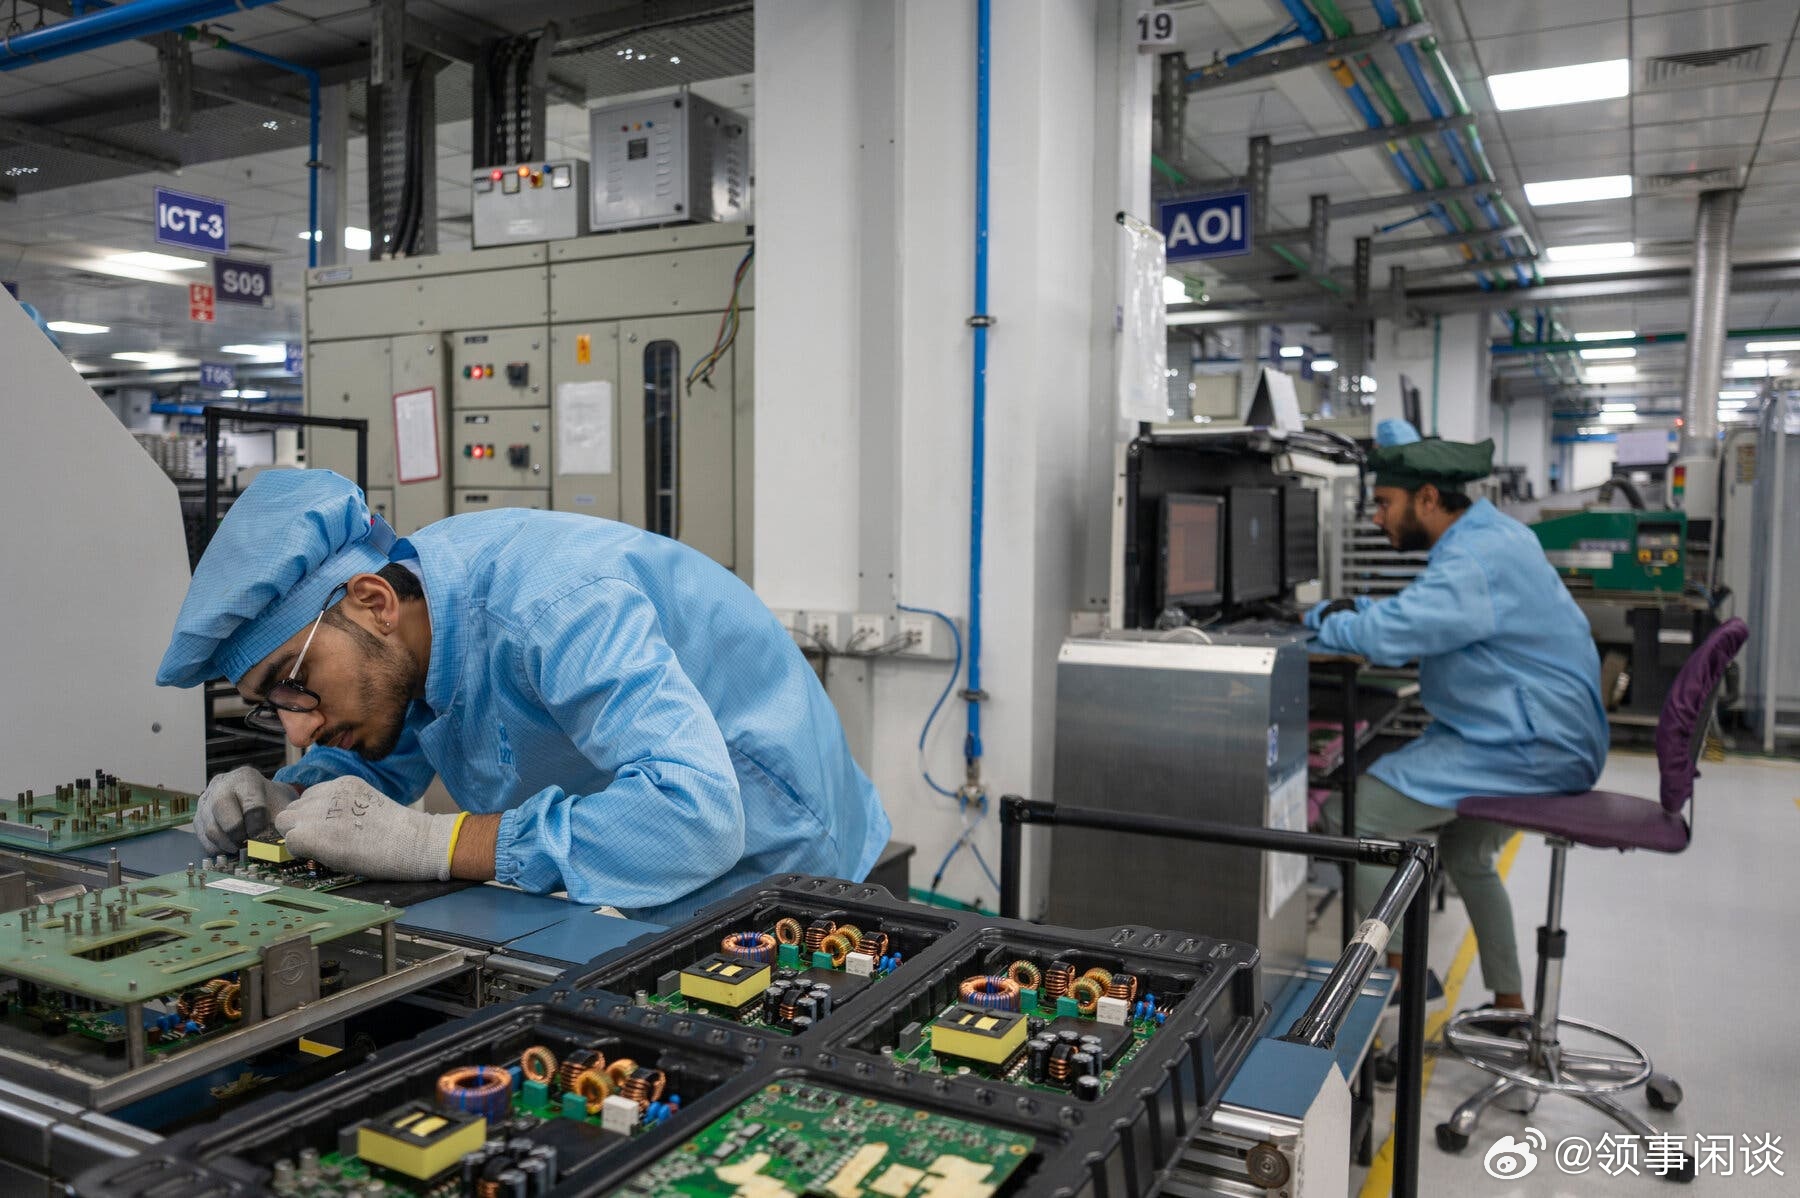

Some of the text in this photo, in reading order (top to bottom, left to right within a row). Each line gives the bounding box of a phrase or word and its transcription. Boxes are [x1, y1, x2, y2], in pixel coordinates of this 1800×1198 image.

[1136, 13, 1172, 41] 19
[159, 203, 224, 240] ICT-3
[1166, 204, 1243, 249] AOI
[222, 268, 266, 297] S09
